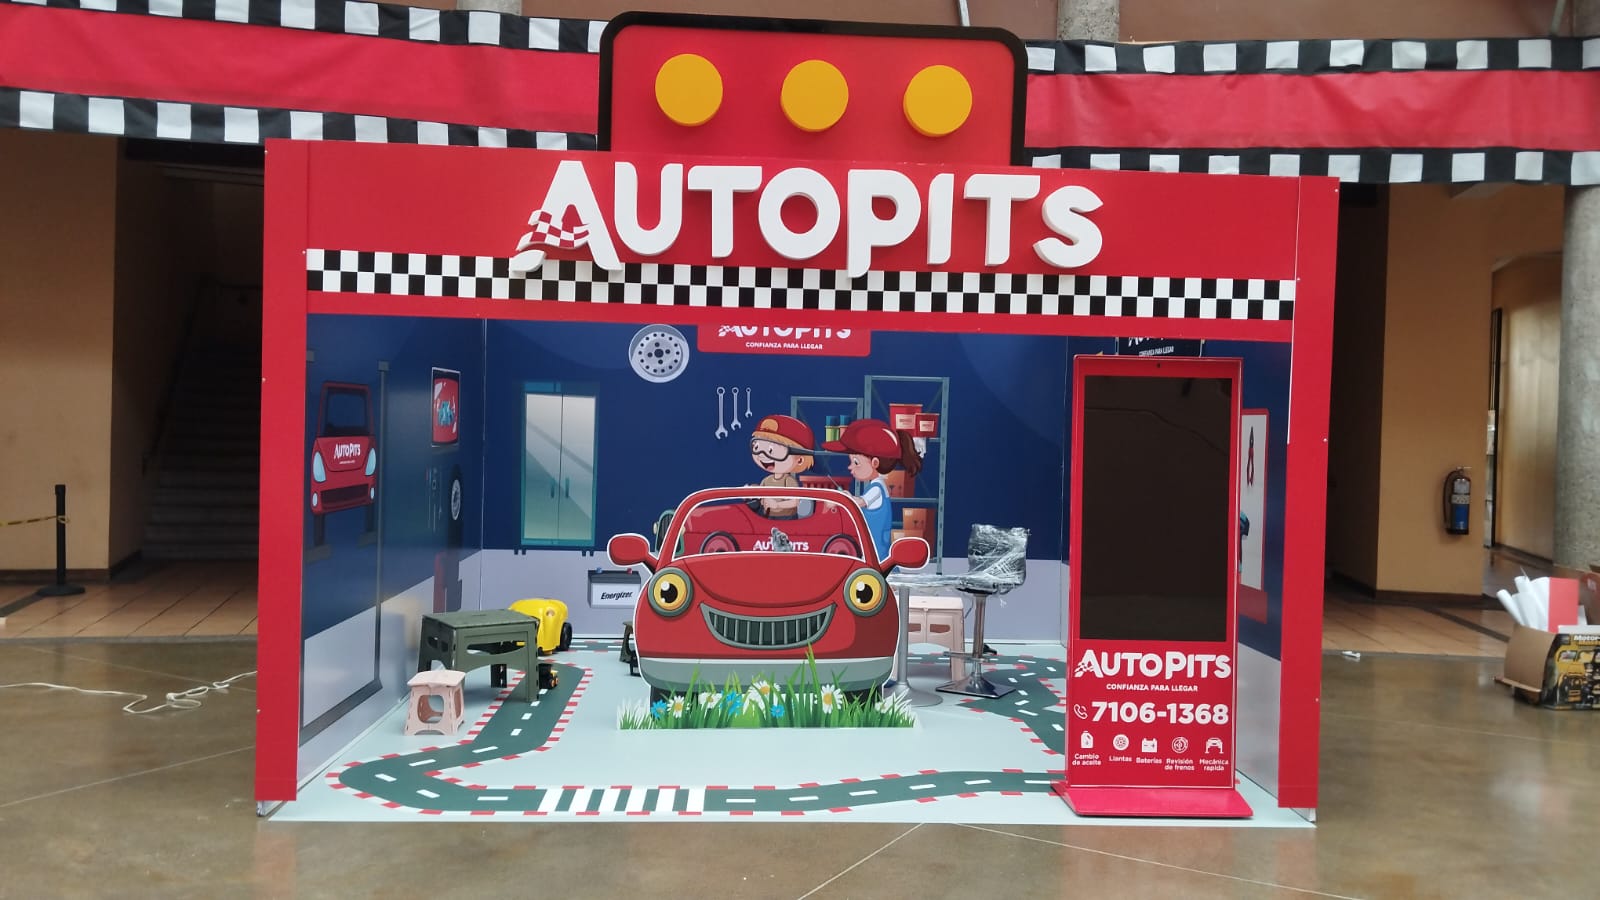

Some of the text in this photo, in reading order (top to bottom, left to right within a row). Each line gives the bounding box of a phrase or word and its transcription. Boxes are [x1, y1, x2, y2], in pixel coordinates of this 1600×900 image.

[509, 160, 1105, 278] AUTOPITS
[745, 341, 782, 349] CONFIANZA
[1074, 649, 1231, 680] AUTOPITS
[1106, 683, 1149, 691] CONFIANZA
[1151, 684, 1170, 692] PARA
[1091, 701, 1229, 725] 7106-1368
